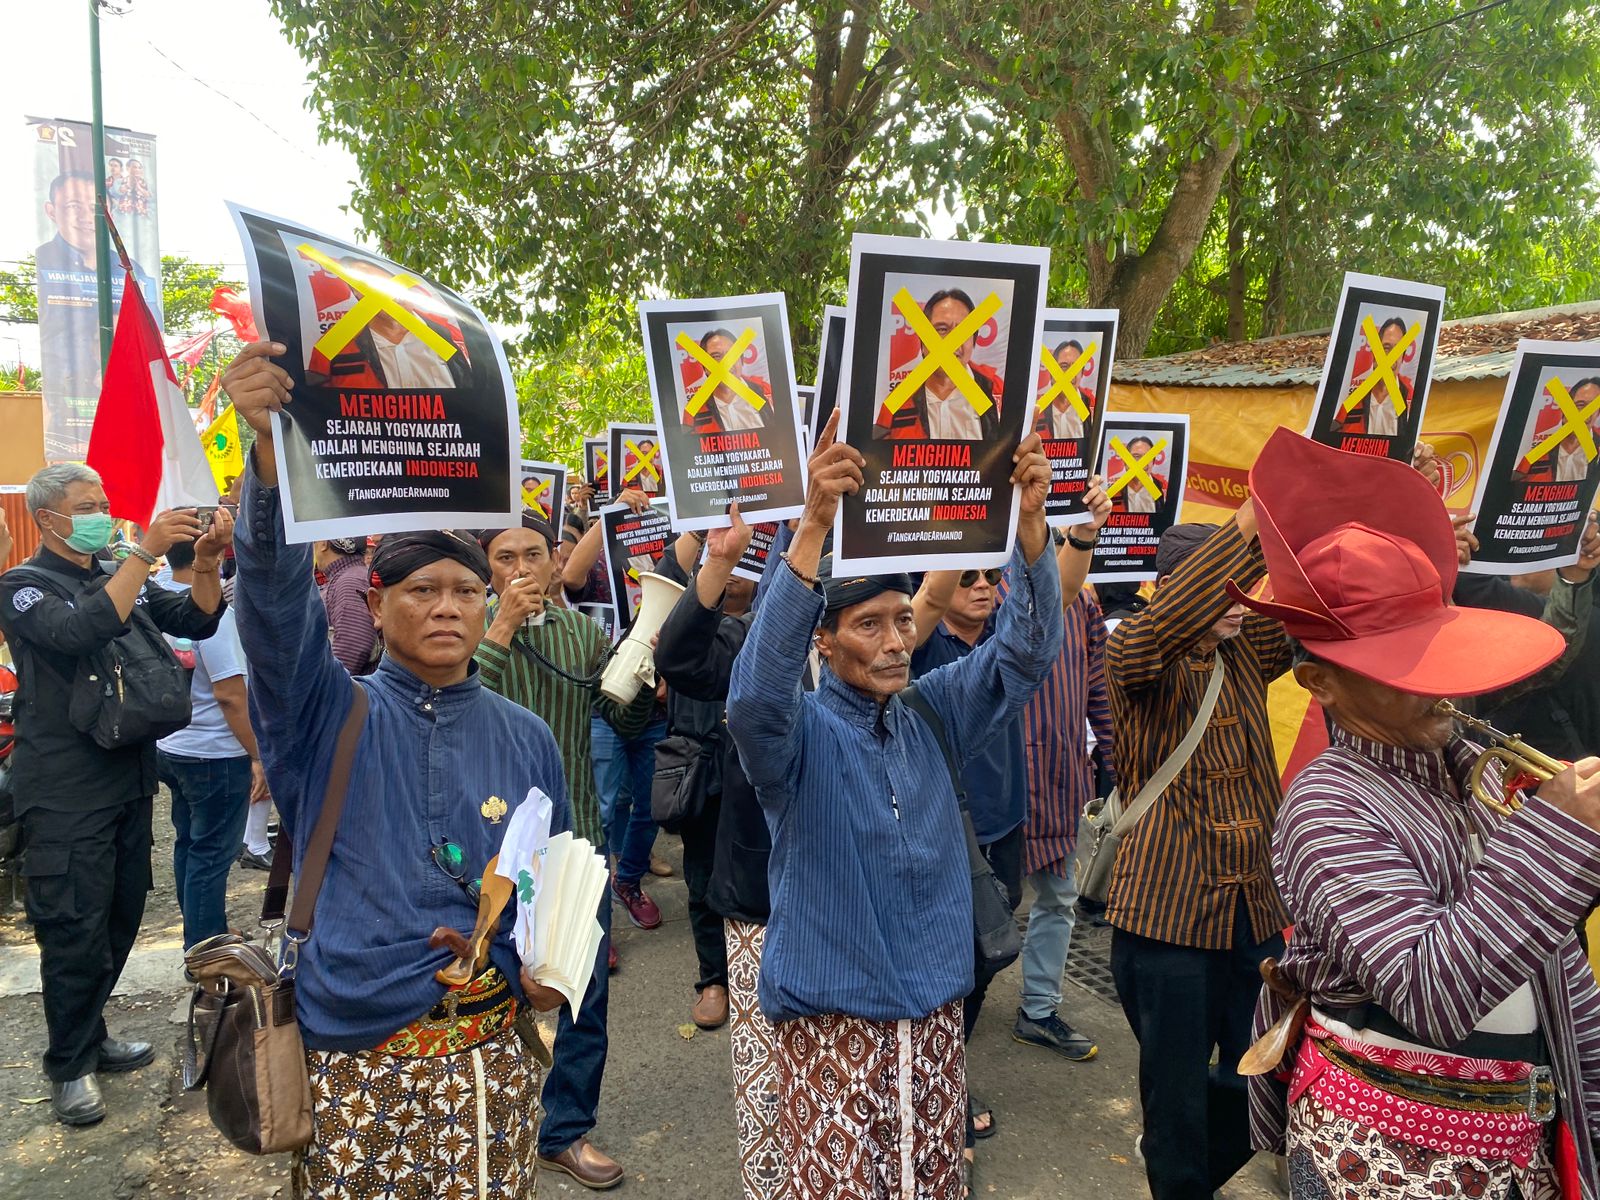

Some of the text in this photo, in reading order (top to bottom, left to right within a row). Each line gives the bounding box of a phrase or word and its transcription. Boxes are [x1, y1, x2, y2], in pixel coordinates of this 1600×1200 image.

[339, 393, 446, 420] MENGHINA
[326, 419, 462, 439] SEJARAH YOGYAKARTA
[311, 439, 481, 458] ADALAH MENGHINA SEJARAH
[699, 431, 761, 453] MENGHINA
[1041, 441, 1078, 458] NGHINA
[1340, 436, 1390, 457] MENGHINA
[694, 448, 771, 466] SEJARAH YOGYAKARTA
[892, 444, 971, 468] MENGHINA
[315, 459, 479, 479] KEMERDEKAAN INDONESIA
[687, 459, 784, 479] ADALAH MENGHINA SEJARAH
[880, 470, 981, 485] SEJARAH YOGYAKARTA
[1064, 468, 1089, 480] SEJARAH
[690, 472, 784, 493] KEMERDEKAAN INDONESIA
[1053, 480, 1085, 494] INDONESIA
[864, 487, 993, 503] ADALAH MENGHINA SEJARAH
[1524, 484, 1579, 502] MENGHINA
[865, 504, 988, 523] KEMERDEKAAN INDONESIA
[1511, 500, 1579, 514] SEJARAH YOGYAKARTA
[1106, 514, 1150, 527] MENGHINA
[1496, 511, 1582, 526] ADALAH MENGHINA SEJARAH
[1100, 527, 1154, 536] SEJARAH YOGYAKARTA
[1137, 536, 1160, 545] SEJARAH
[1493, 528, 1545, 540] KEMERDEKAAN
